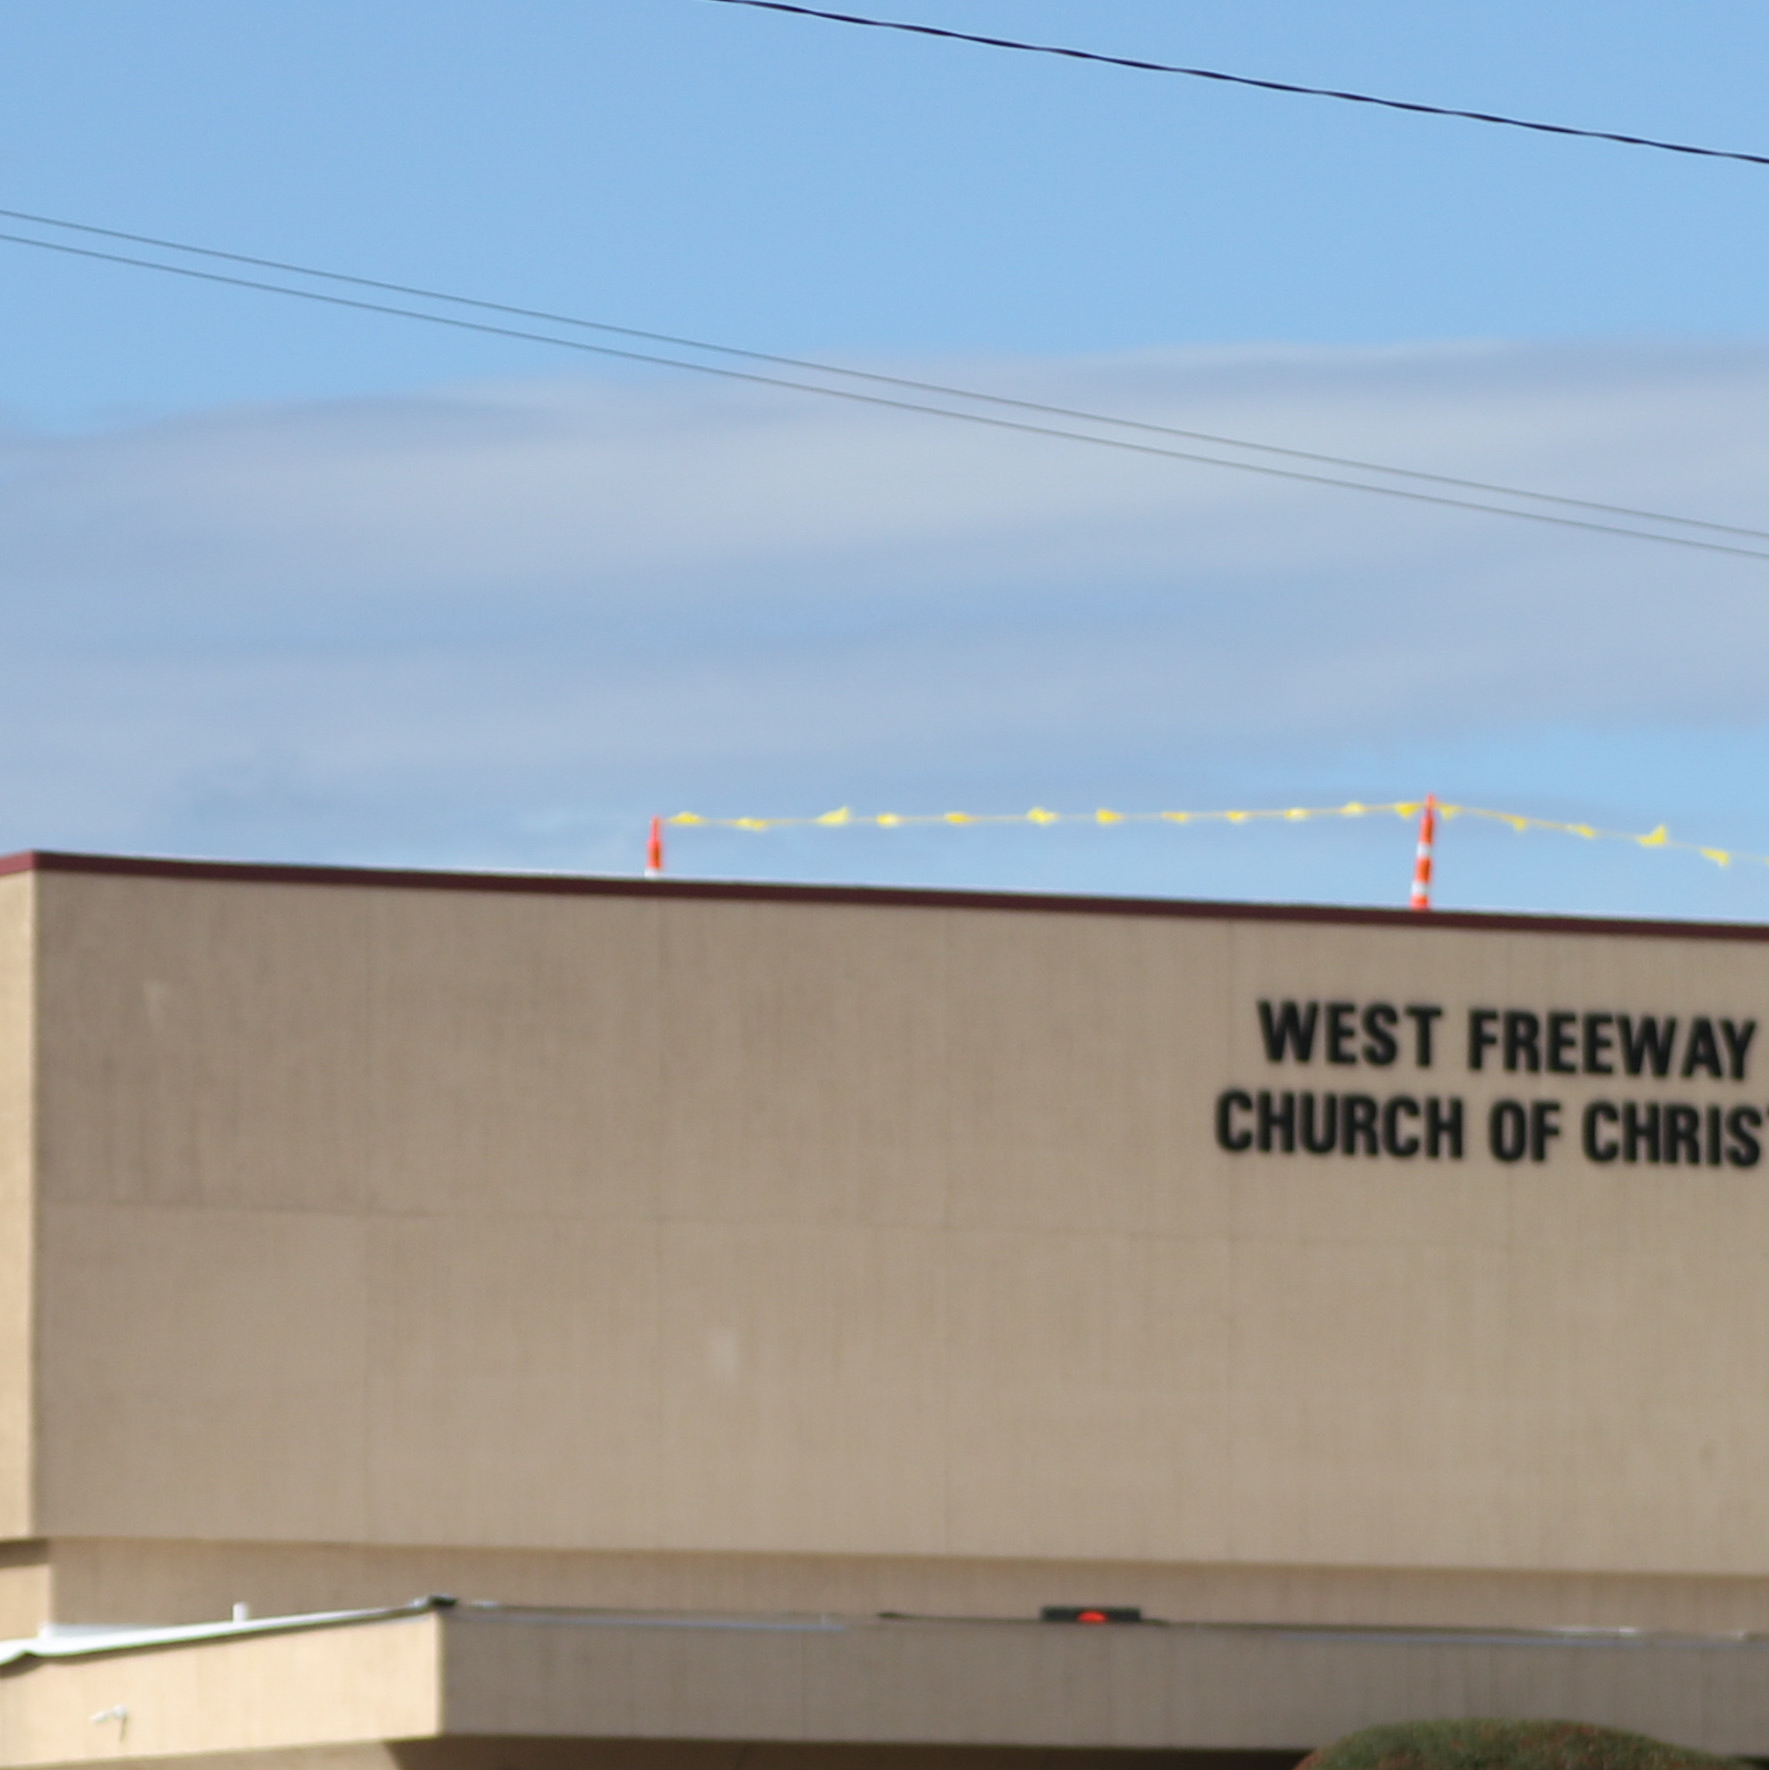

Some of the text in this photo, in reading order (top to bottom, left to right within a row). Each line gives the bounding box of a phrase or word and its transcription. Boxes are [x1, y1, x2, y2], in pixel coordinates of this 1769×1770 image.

[1258, 1000, 1758, 1081] WEST FREEWAY
[1215, 1089, 1465, 1160] CHURCH
[1488, 1098, 1562, 1164] OF
